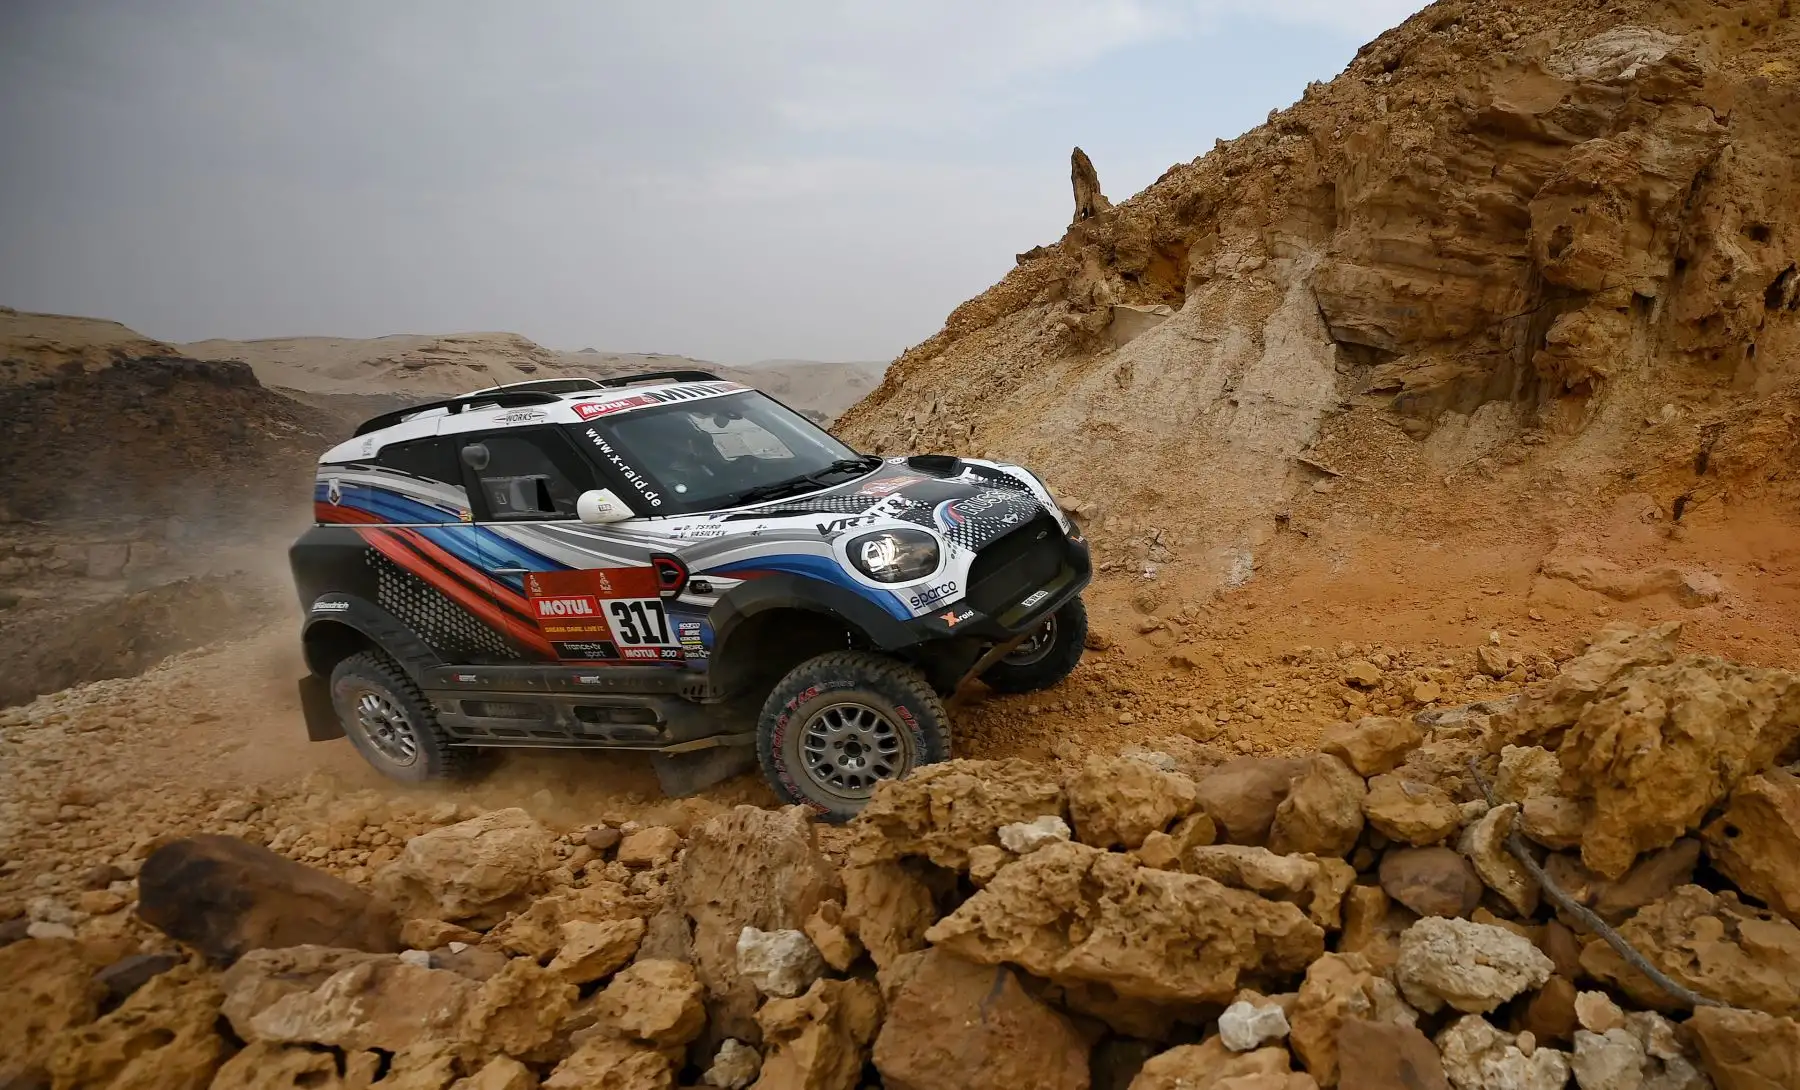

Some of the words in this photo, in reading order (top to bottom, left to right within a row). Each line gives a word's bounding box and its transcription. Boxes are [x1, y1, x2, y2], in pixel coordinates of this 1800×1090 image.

[581, 399, 630, 415] MOTUL
[506, 413, 533, 421] WORKS
[585, 428, 662, 507] www.x-raid.de
[910, 581, 957, 608] sparco
[538, 600, 593, 615] MOTUL
[610, 601, 669, 645] 317
[625, 649, 658, 658] MOTUL
